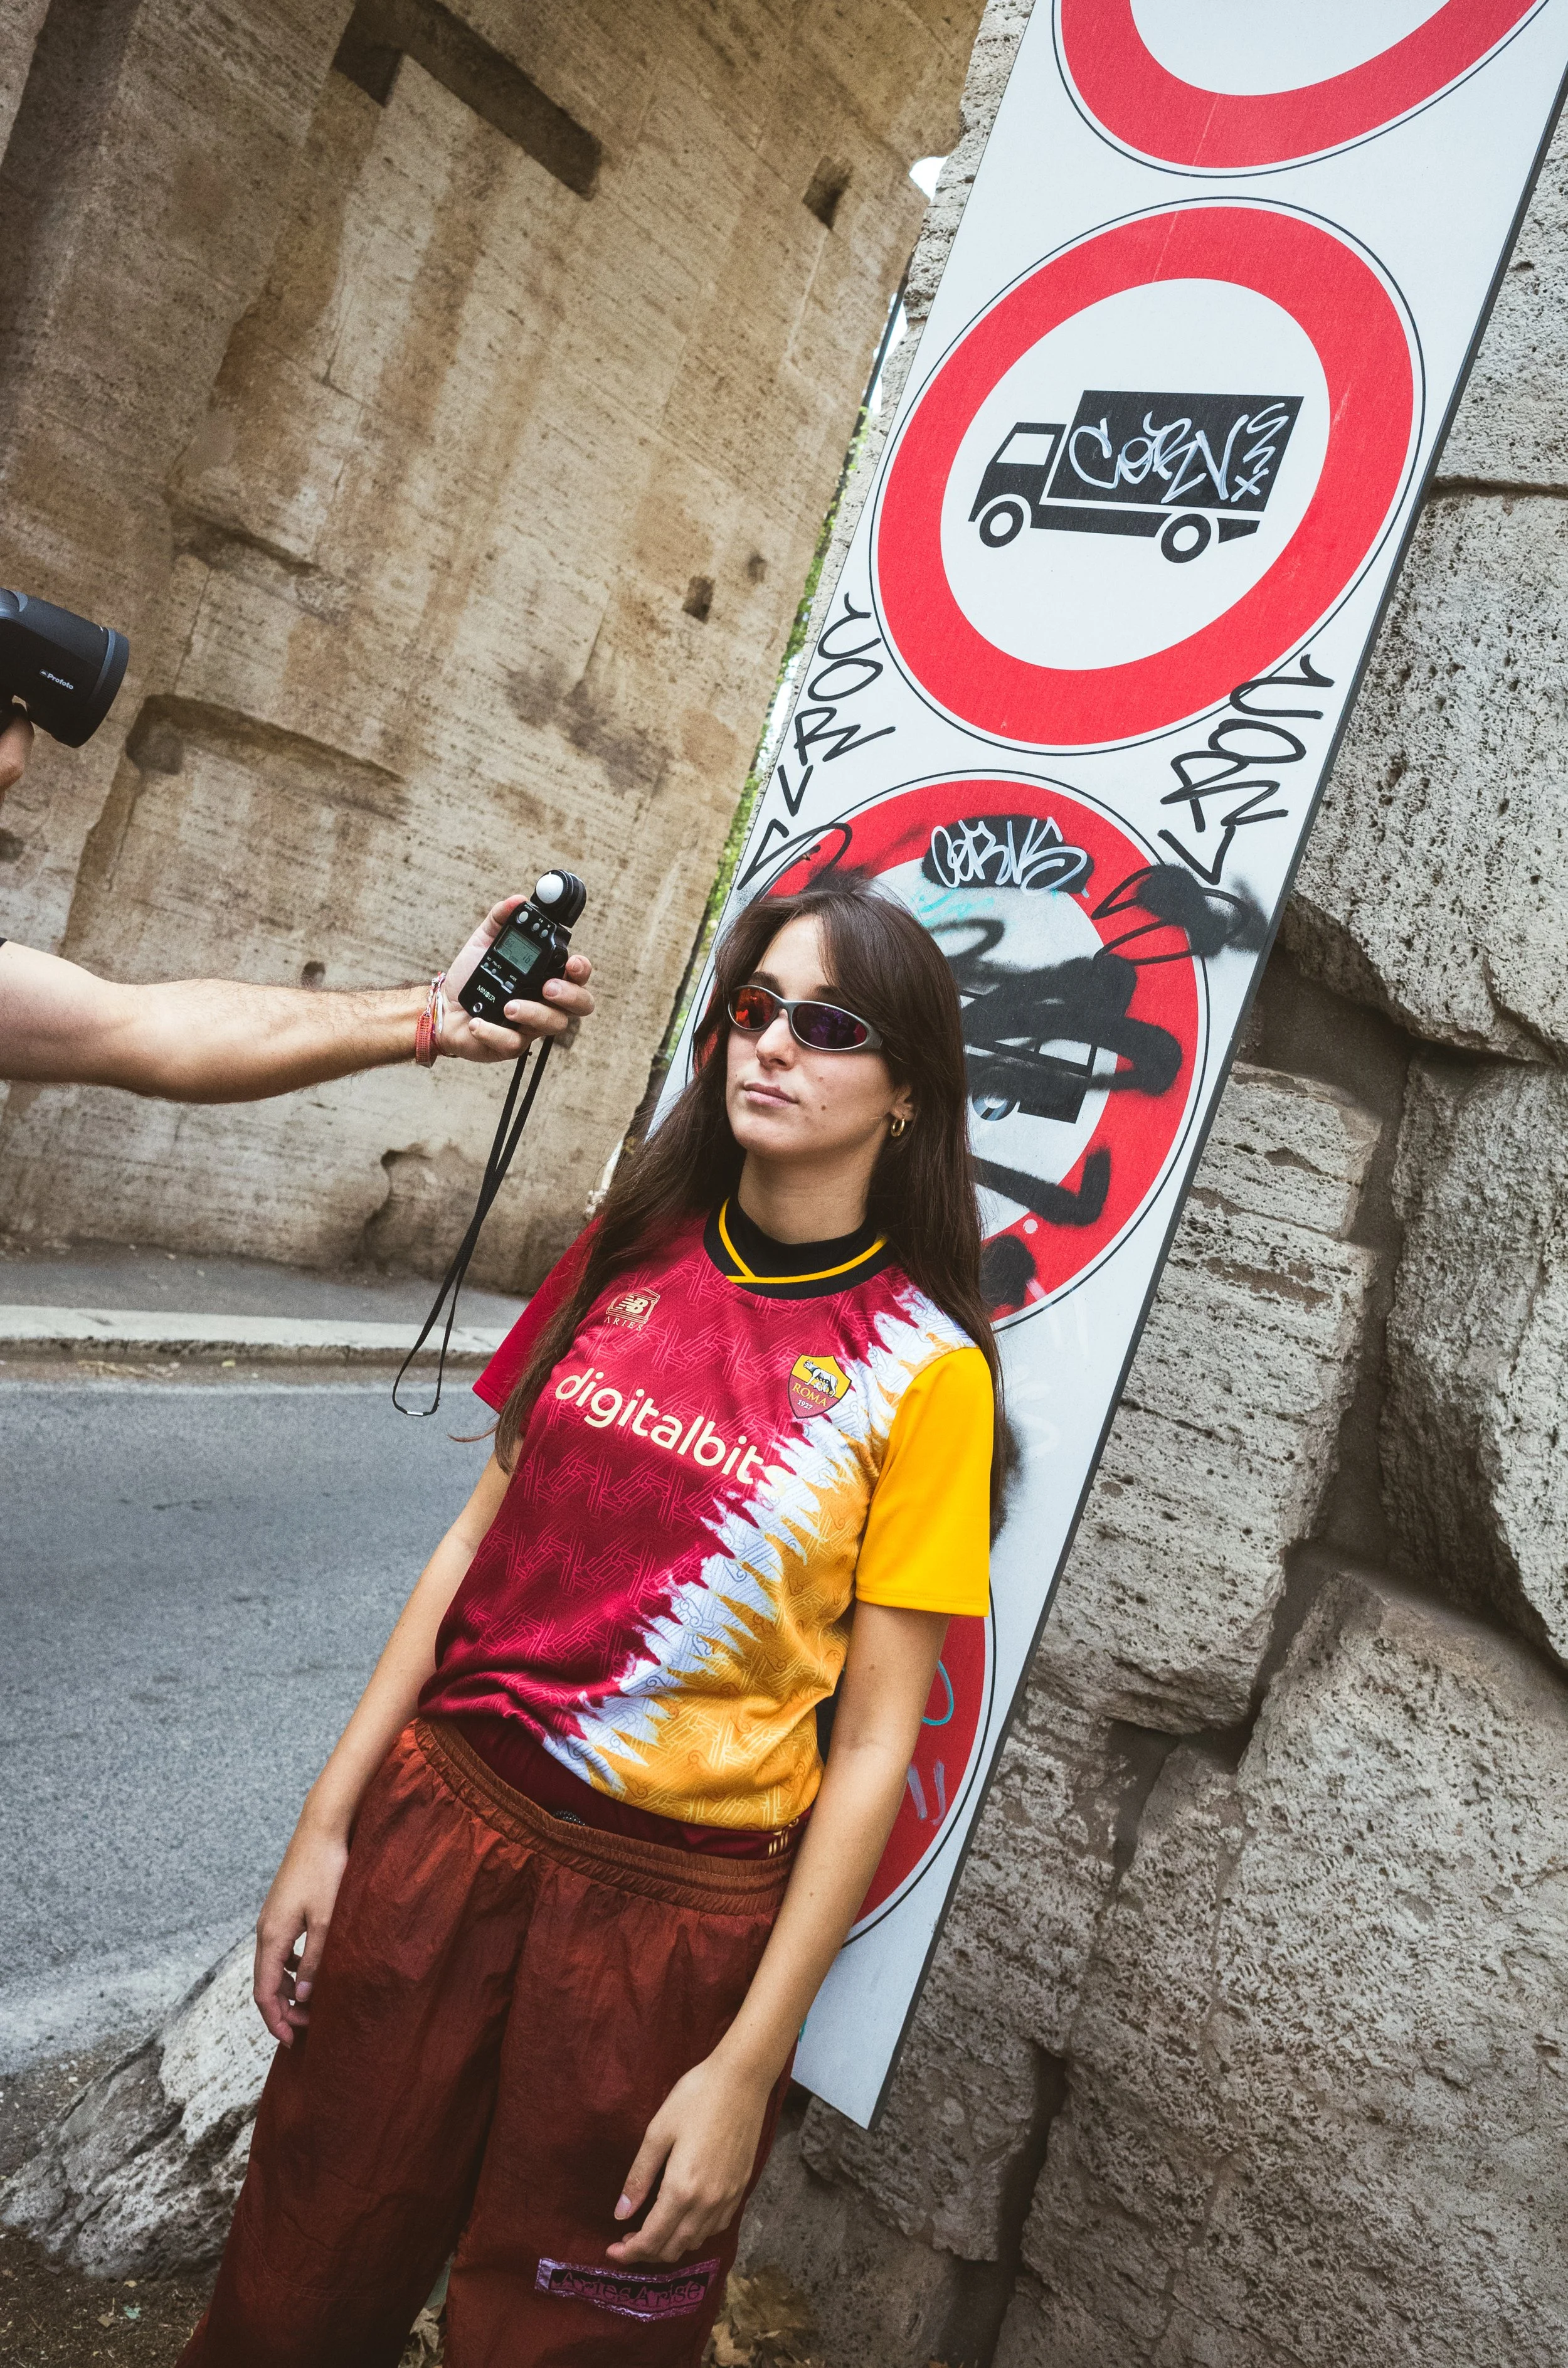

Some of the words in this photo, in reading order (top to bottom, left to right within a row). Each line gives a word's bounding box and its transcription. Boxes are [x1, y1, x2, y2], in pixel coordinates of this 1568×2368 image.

[46, 672, 74, 690] Profoto
[477, 985, 495, 1003] MINOLTA
[604, 1316, 644, 1331] ARIES
[792, 1382, 827, 1407] ROMA
[797, 1399, 813, 1410] 1927
[554, 1367, 792, 1498] digitalbits
